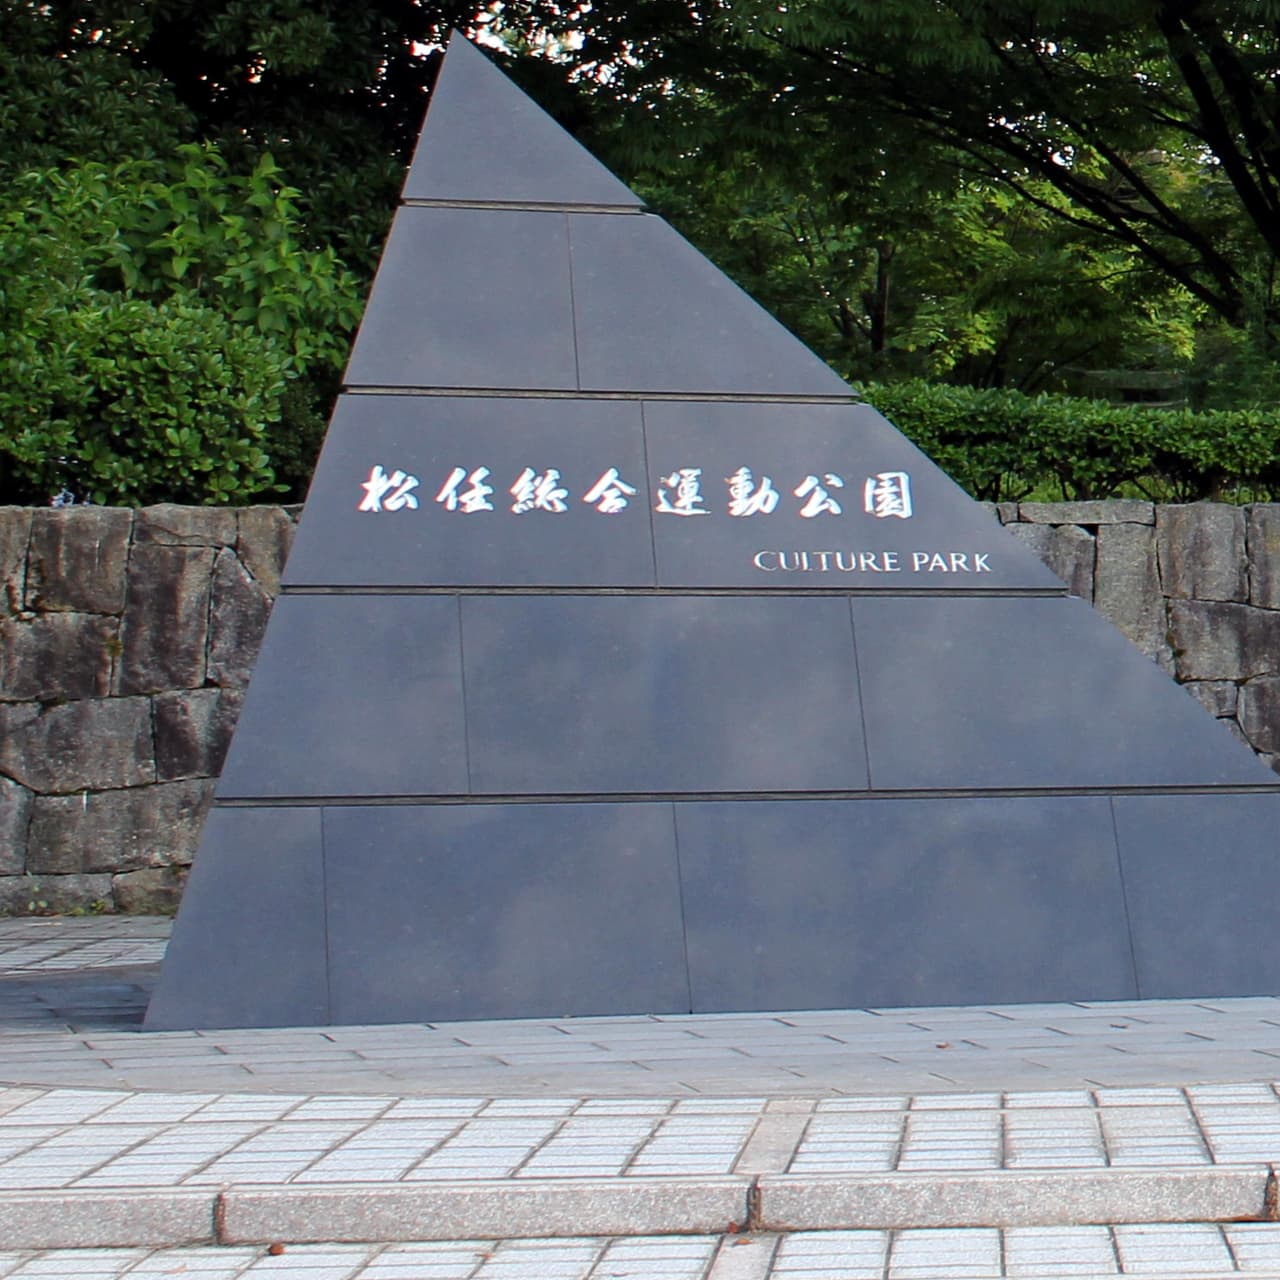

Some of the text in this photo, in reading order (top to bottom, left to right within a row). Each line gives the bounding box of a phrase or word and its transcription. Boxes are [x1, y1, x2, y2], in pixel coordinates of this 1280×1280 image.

[358, 465, 913, 519] 松任総合運動公園
[753, 550, 992, 574] CULTURE PARK
